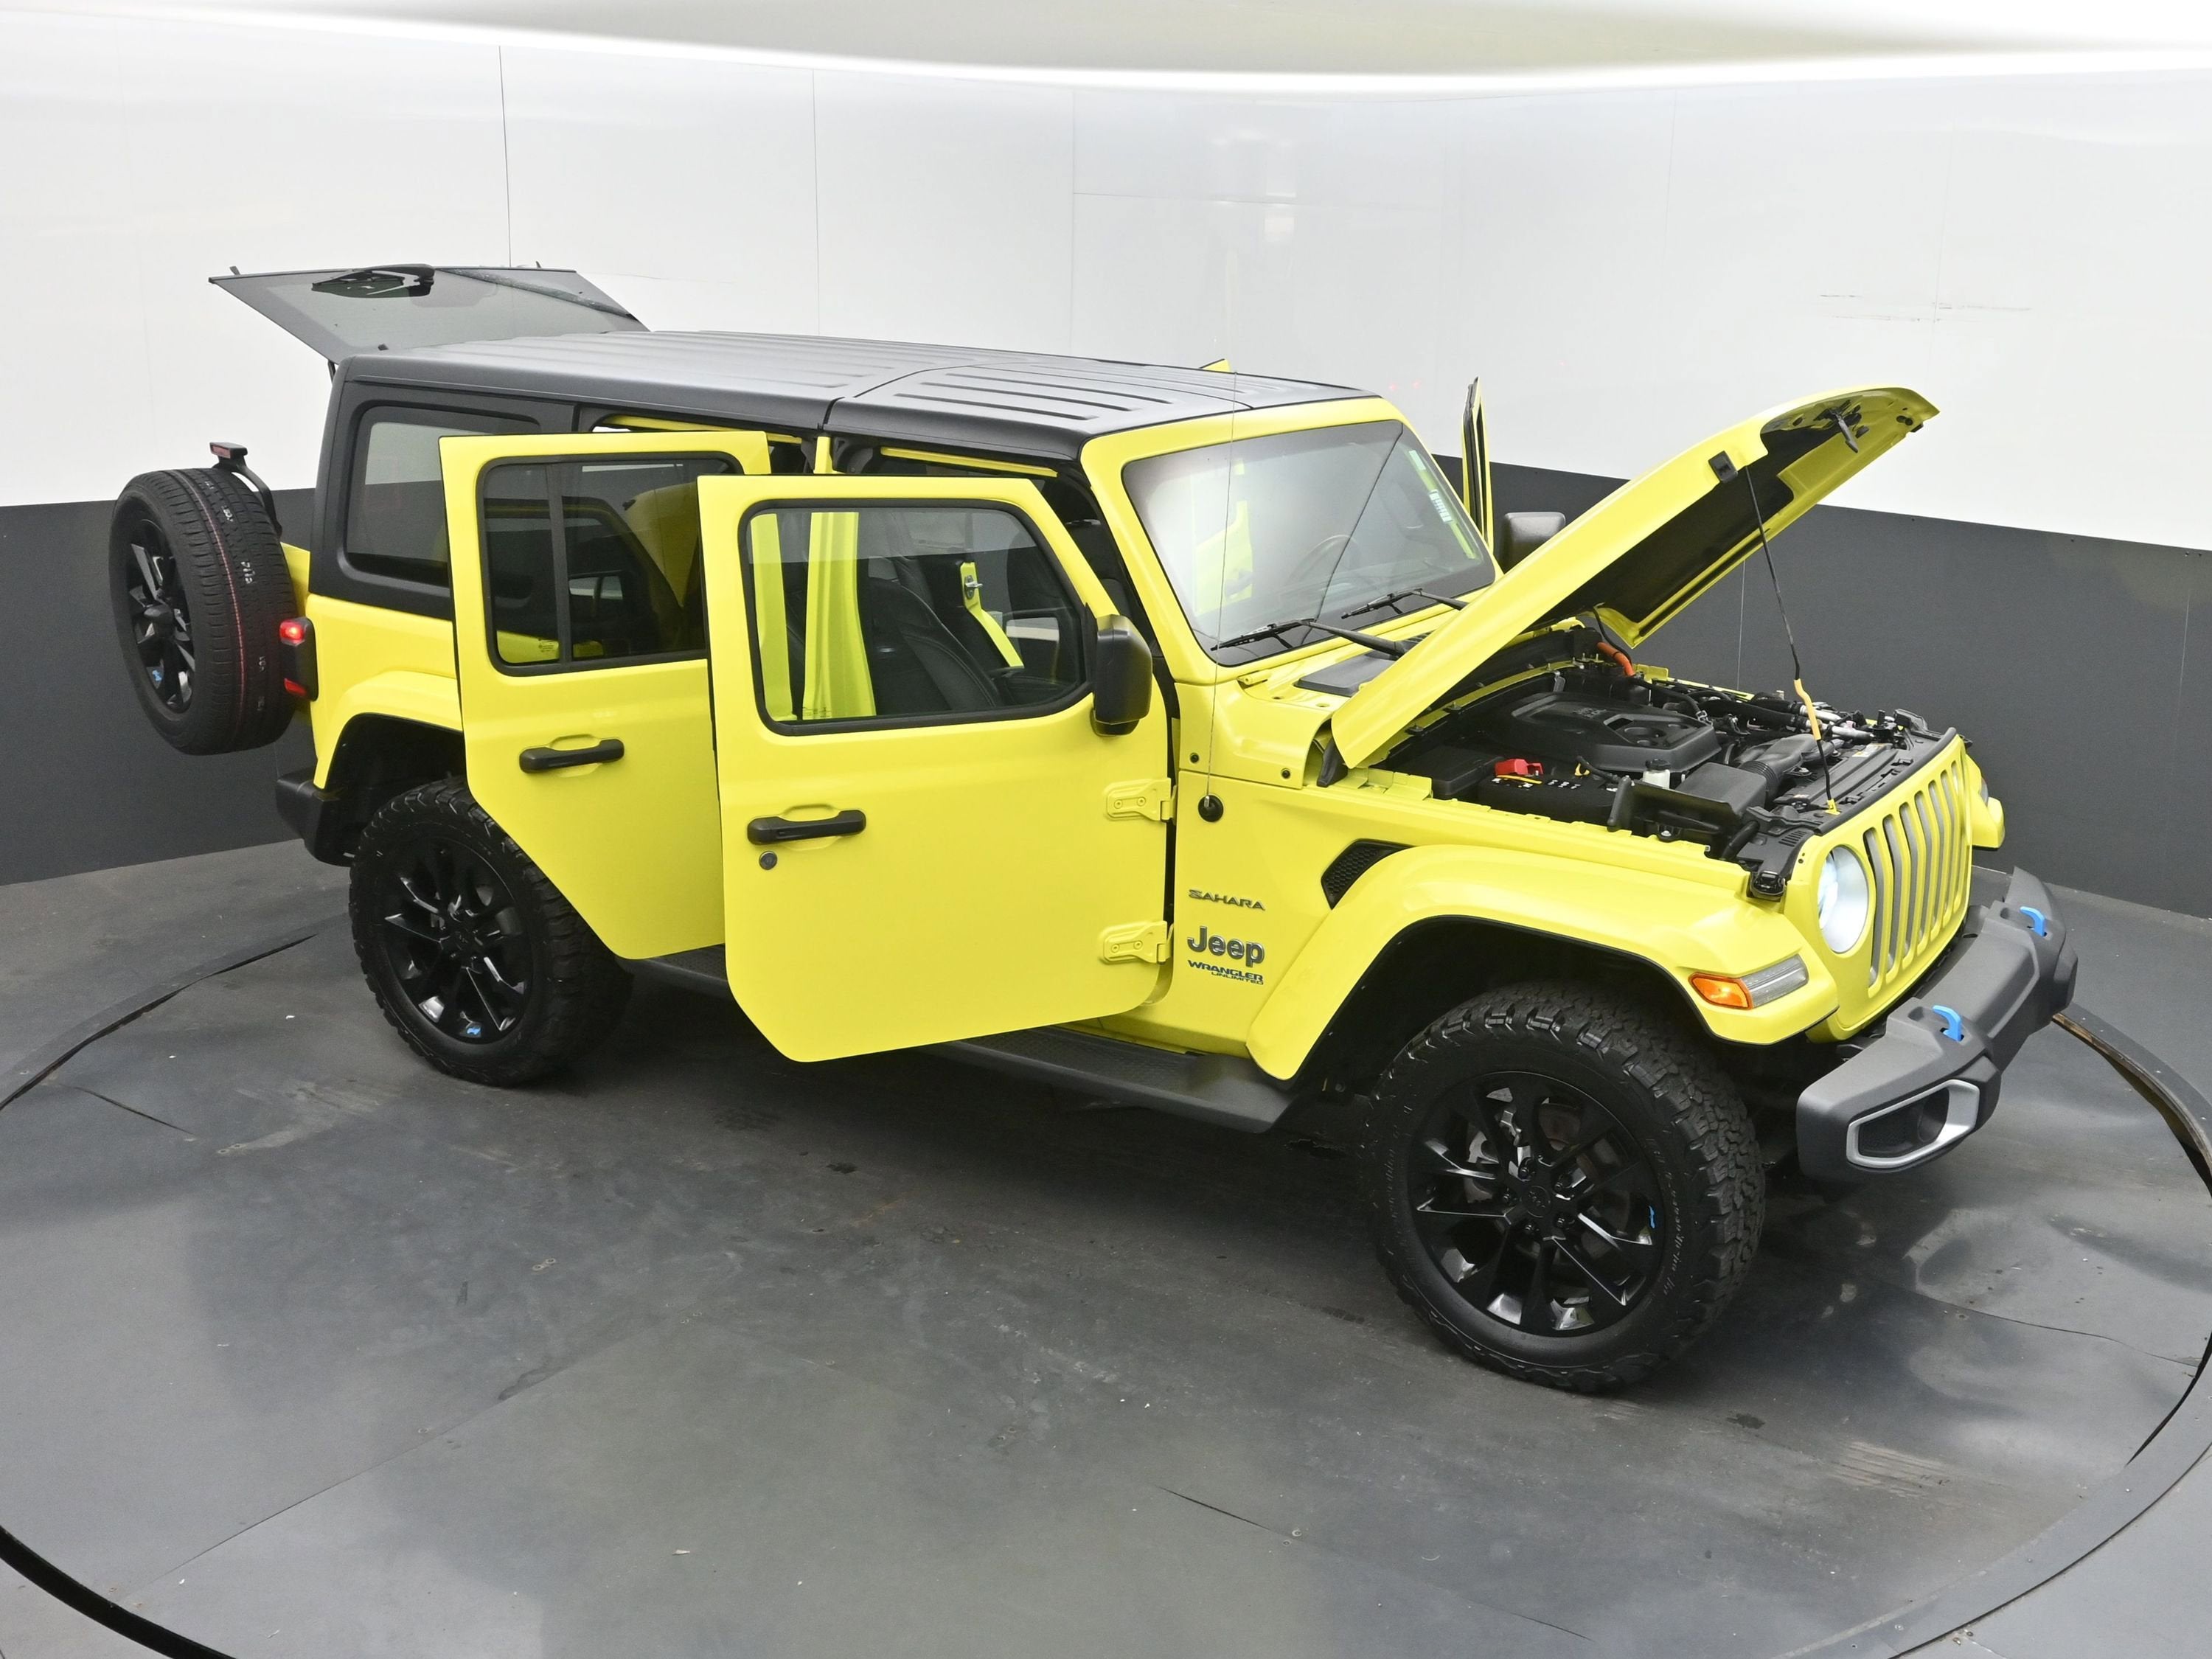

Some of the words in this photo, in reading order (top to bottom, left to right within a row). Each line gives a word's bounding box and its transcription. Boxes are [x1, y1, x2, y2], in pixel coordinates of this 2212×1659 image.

[1189, 889, 1265, 911] SAHARA
[1187, 926, 1265, 967] Jeep
[1188, 961, 1263, 981] WRANGLER
[1211, 973, 1264, 985] UNLIMITED
